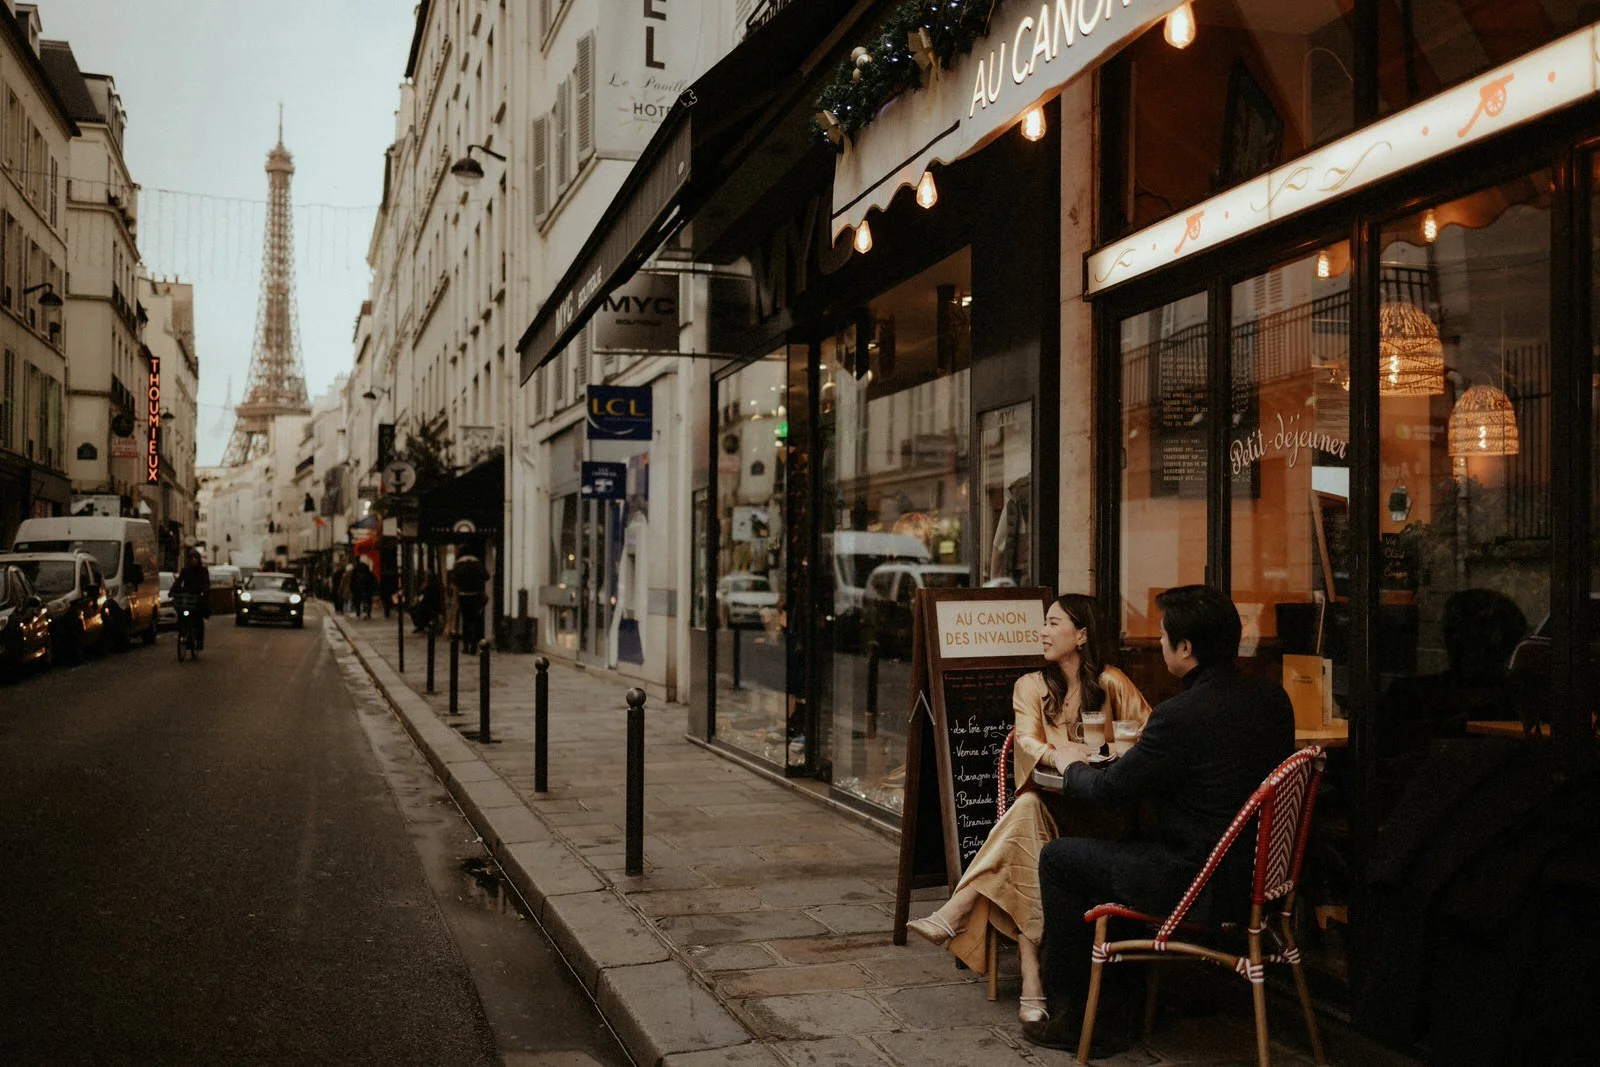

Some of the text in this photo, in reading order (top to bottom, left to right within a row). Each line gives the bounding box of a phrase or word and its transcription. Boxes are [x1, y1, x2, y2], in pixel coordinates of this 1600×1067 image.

[968, 0, 1131, 118] AU CANO
[608, 73, 688, 93] Le Pavill
[603, 296, 675, 315] MYC
[592, 398, 647, 416] LCL
[149, 359, 160, 481] THOUMIEUX
[955, 611, 1026, 626] AU CANON
[946, 630, 1040, 646] DES INVALIDES
